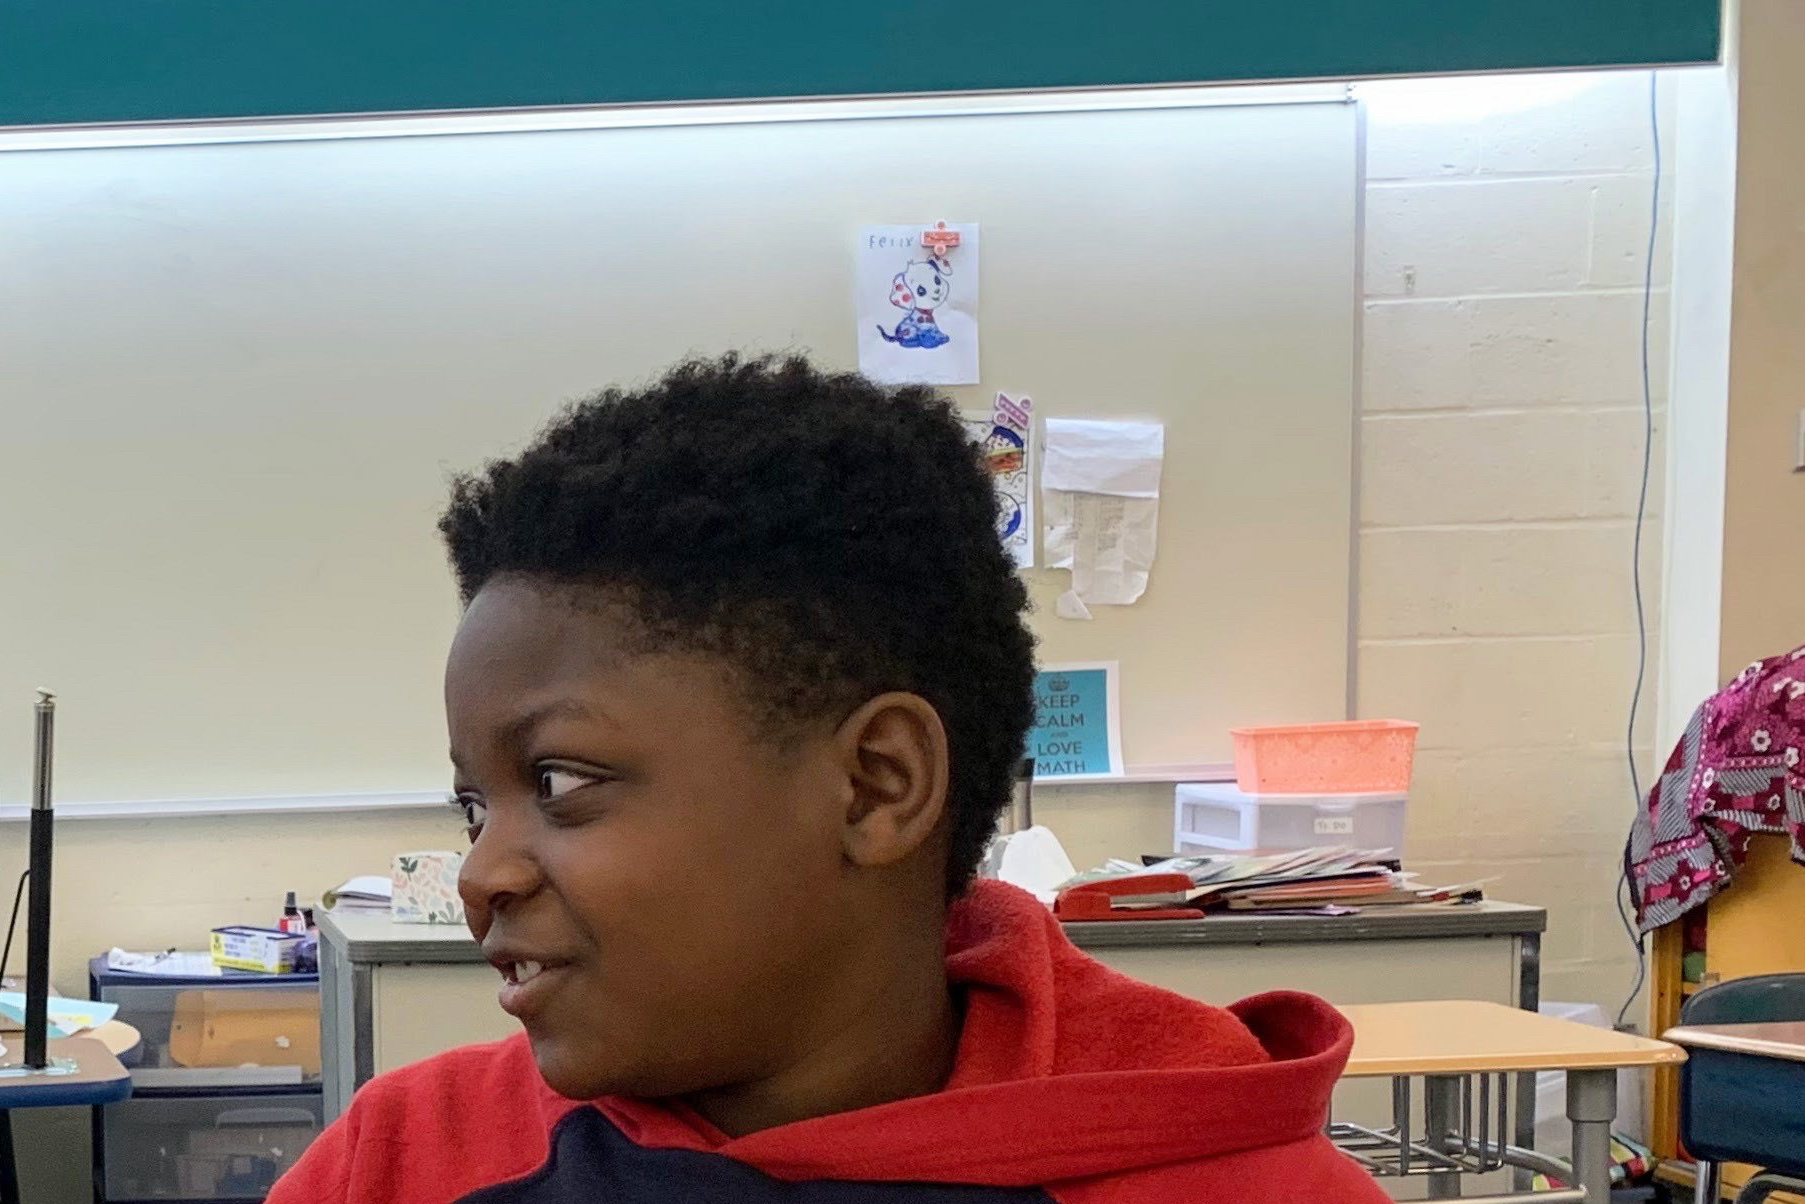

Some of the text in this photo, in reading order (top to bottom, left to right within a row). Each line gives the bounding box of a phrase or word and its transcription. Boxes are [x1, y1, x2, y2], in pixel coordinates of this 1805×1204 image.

[1036, 694, 1080, 709] KEEP
[1035, 713, 1084, 728] CALM
[1037, 741, 1083, 756] LOVE
[1037, 760, 1086, 775] MATH
